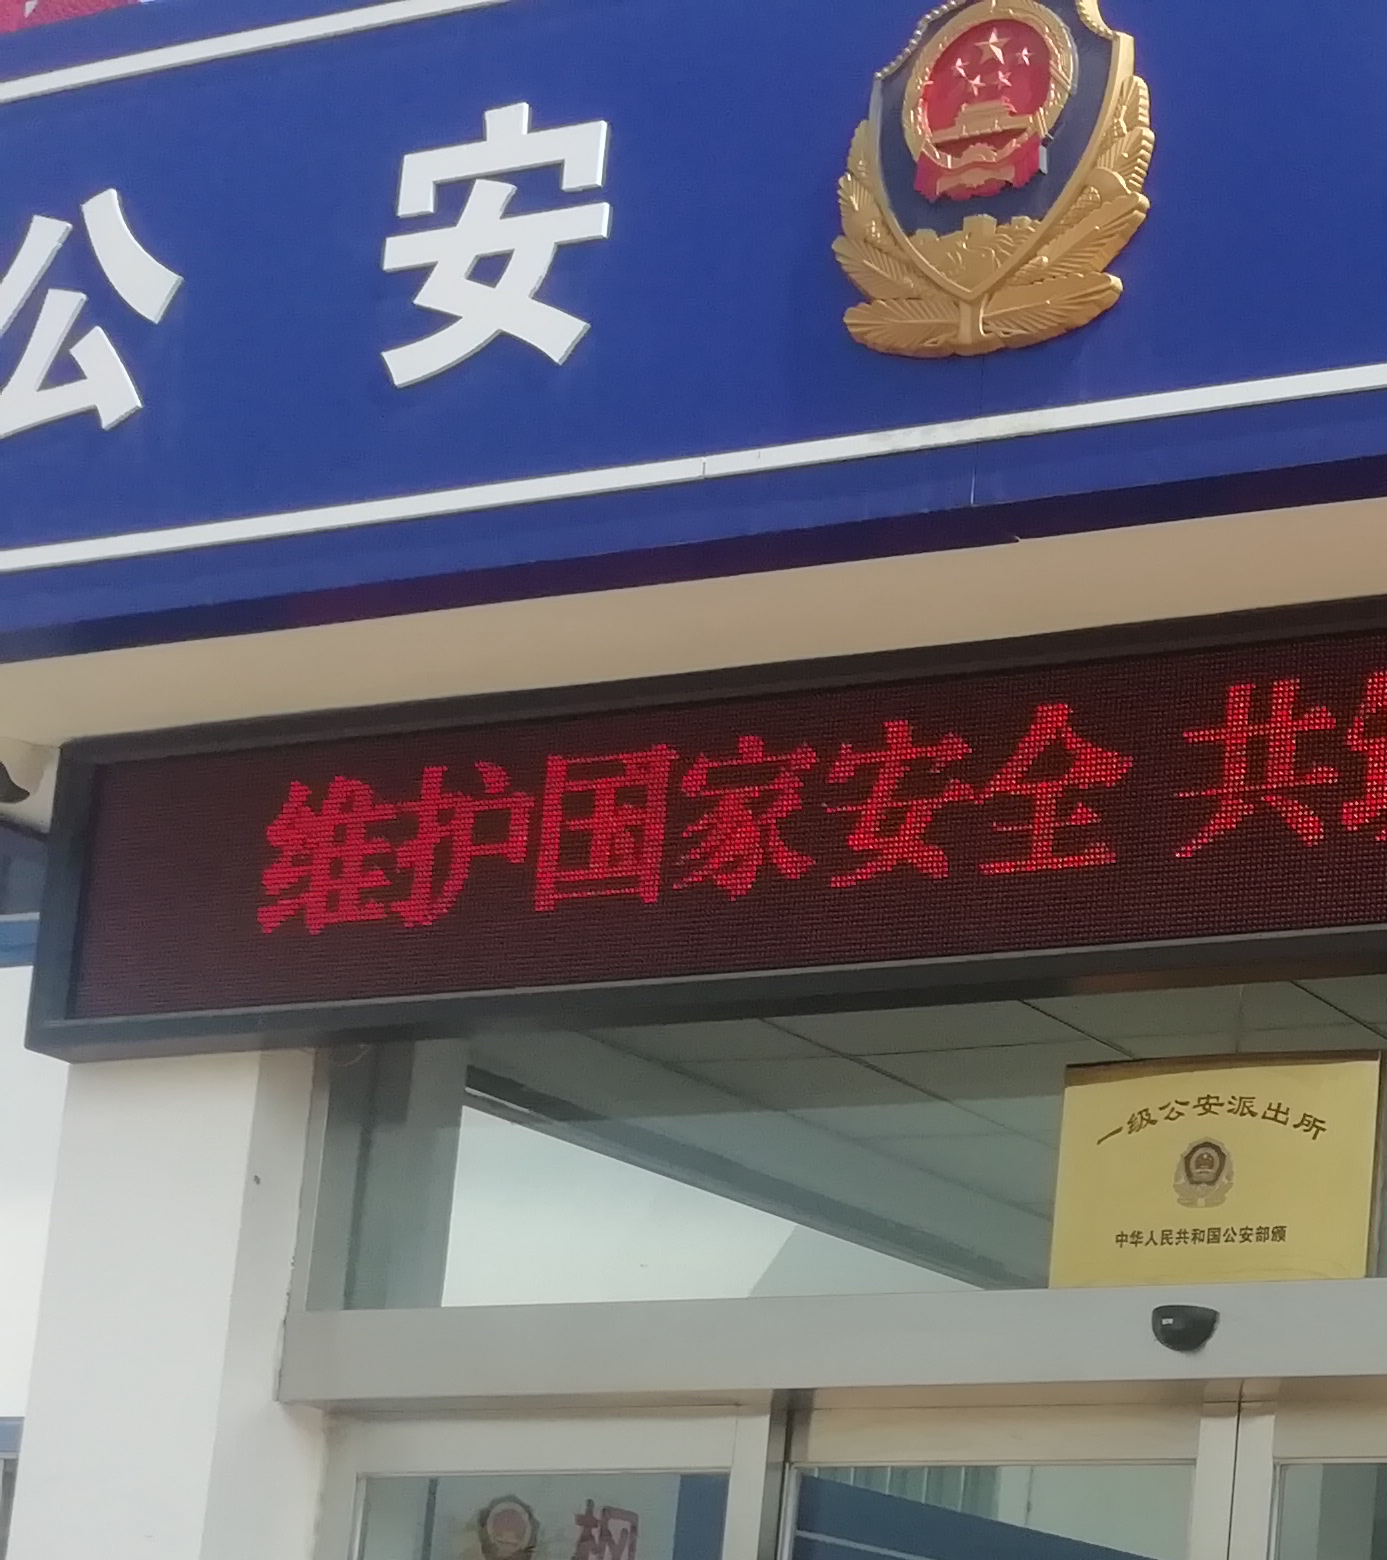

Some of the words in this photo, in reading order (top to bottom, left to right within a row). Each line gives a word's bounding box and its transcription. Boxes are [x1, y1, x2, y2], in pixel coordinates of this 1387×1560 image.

[0, 102, 611, 438] 公安
[256, 702, 1134, 934] 维护国家安全
[1096, 1094, 1328, 1146] 一级公安派出所
[1115, 1225, 1288, 1248] 中华人民共和国公安部颁
